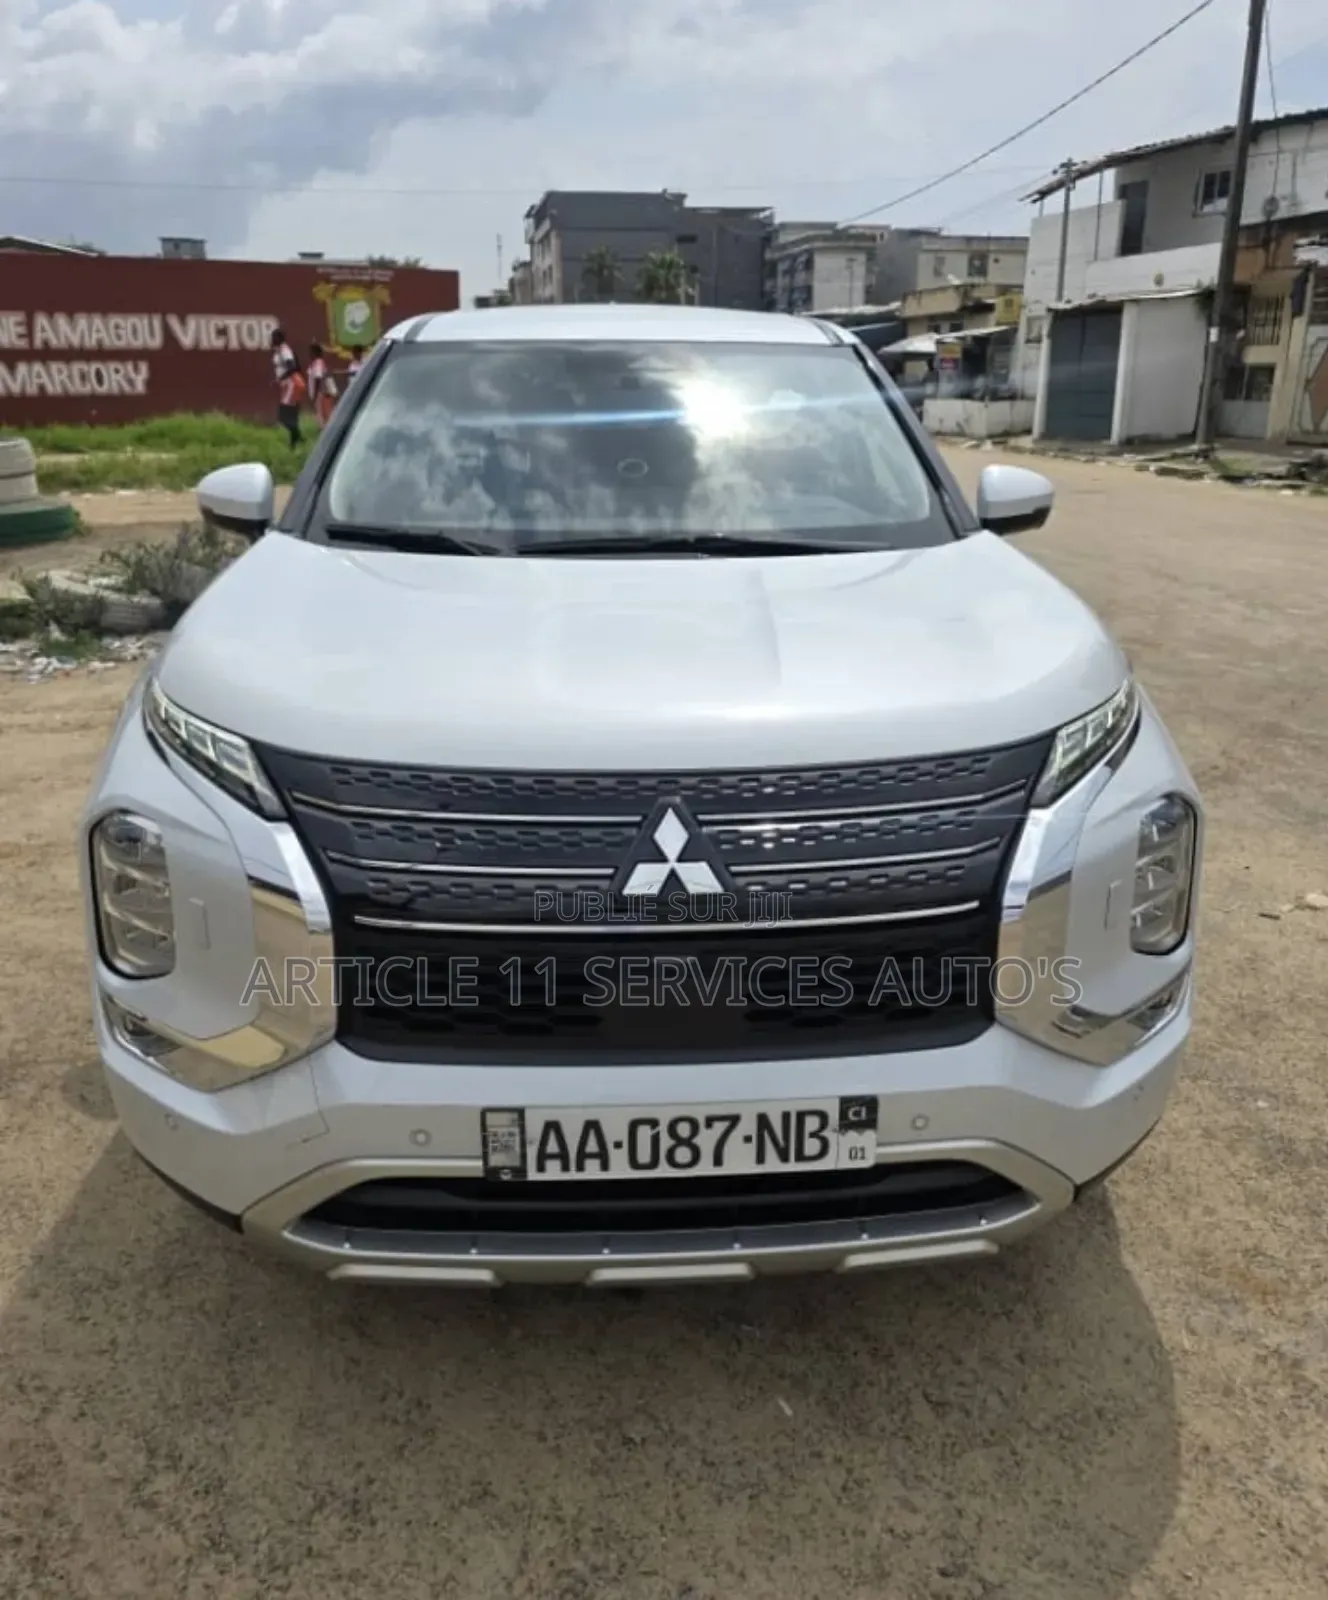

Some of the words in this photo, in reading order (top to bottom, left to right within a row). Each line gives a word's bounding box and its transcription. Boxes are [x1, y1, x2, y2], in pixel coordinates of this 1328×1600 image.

[33, 311, 164, 350] AMAGOU
[0, 360, 148, 397] MARCORY
[848, 1146, 866, 1161] 01
